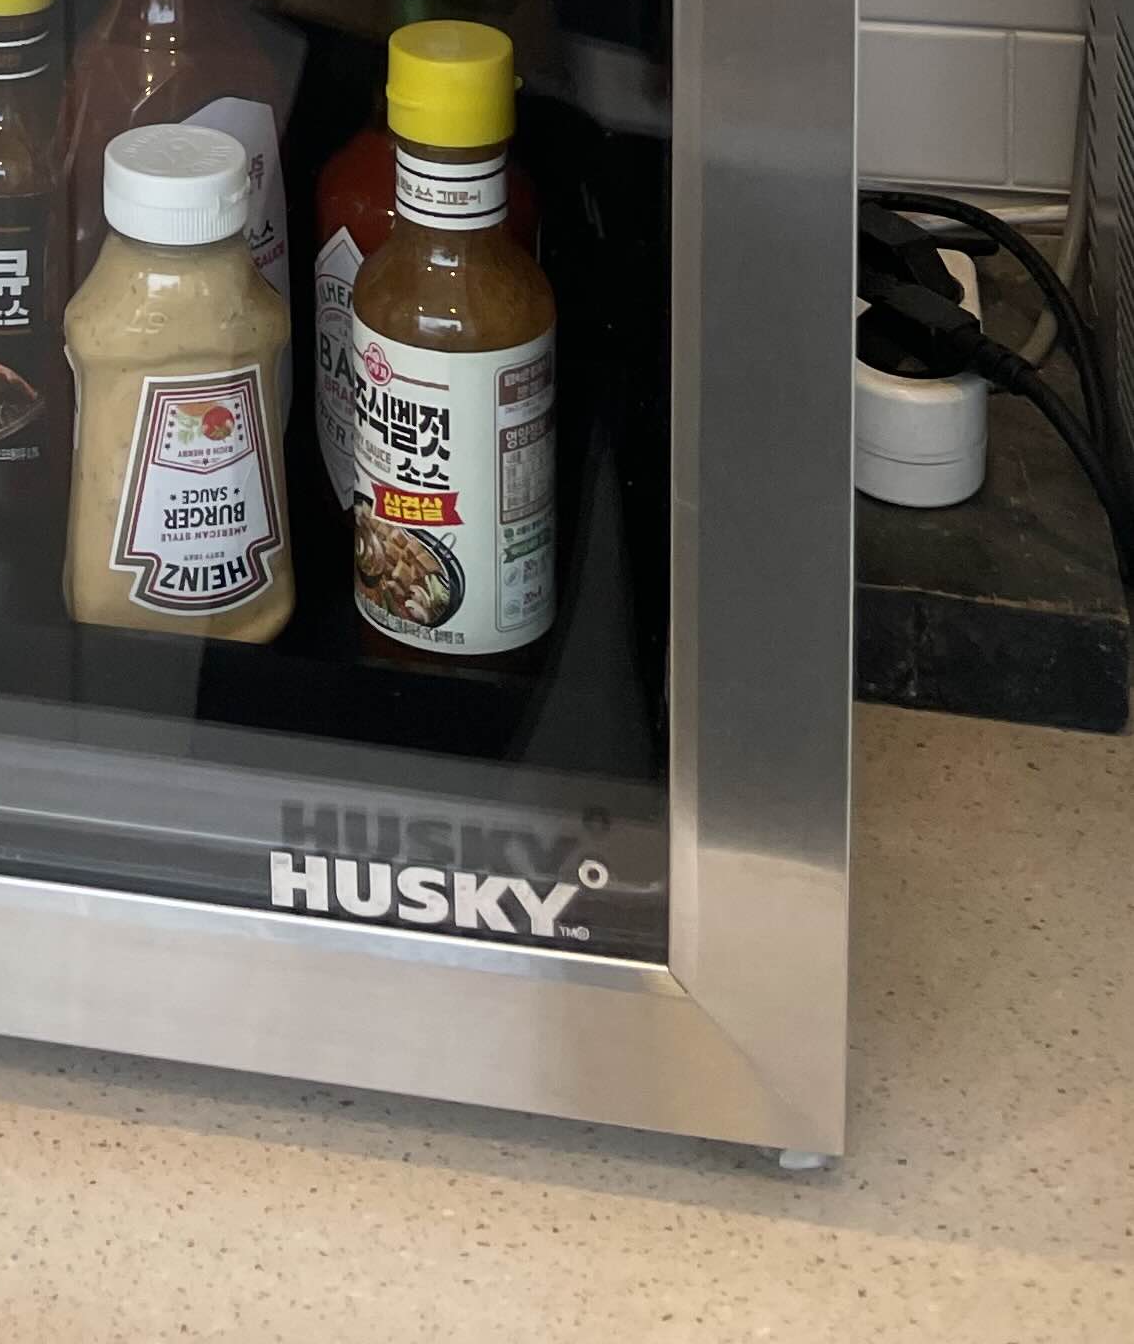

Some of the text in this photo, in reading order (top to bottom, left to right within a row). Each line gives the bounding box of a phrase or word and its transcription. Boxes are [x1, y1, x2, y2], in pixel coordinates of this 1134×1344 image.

[396, 457, 450, 490] 소스
[182, 486, 228, 504] SAUCE
[383, 490, 443, 522] 삼겹살
[164, 501, 245, 530] BURGER
[161, 524, 248, 542] AMERICAN STYLE
[160, 556, 248, 592] HEINZ
[270, 850, 580, 938] HUSKY
